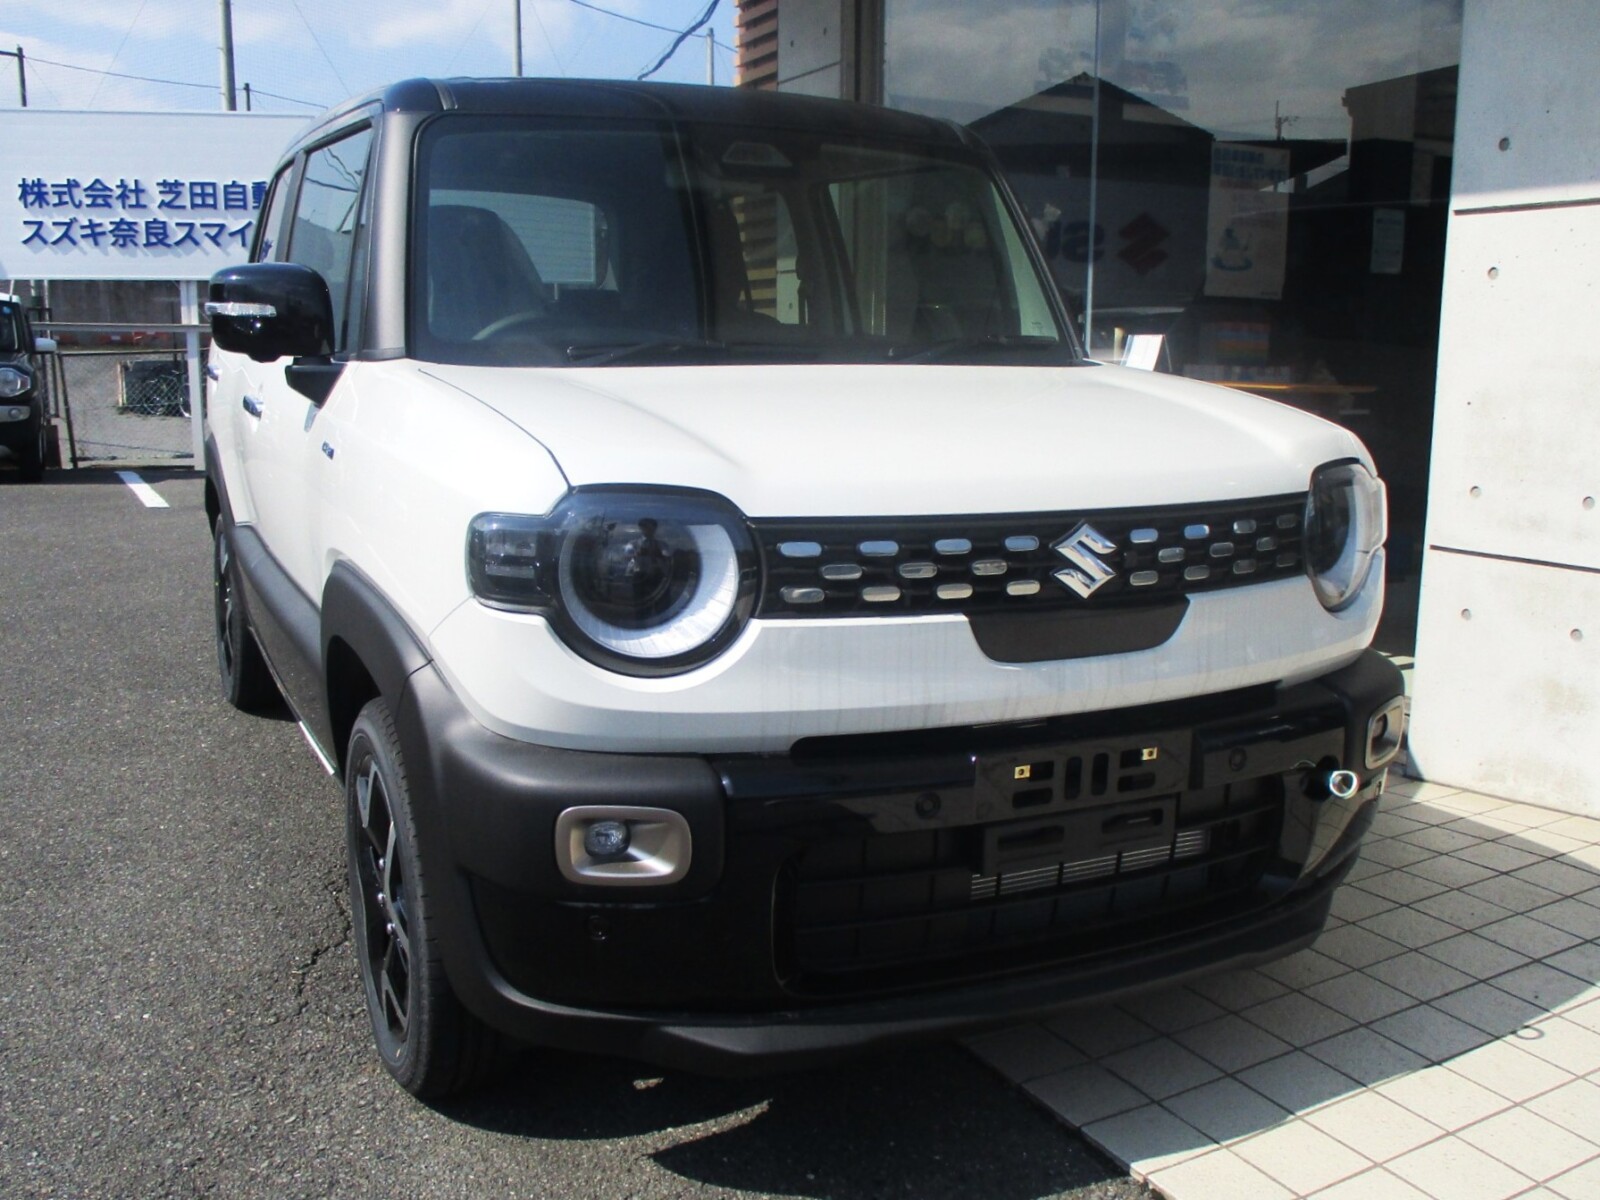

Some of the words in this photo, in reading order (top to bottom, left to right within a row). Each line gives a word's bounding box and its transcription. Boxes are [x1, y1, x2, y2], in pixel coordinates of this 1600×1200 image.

[18, 178, 148, 209] 株式会社
[22, 217, 253, 248] スズキ奈良スマイ
